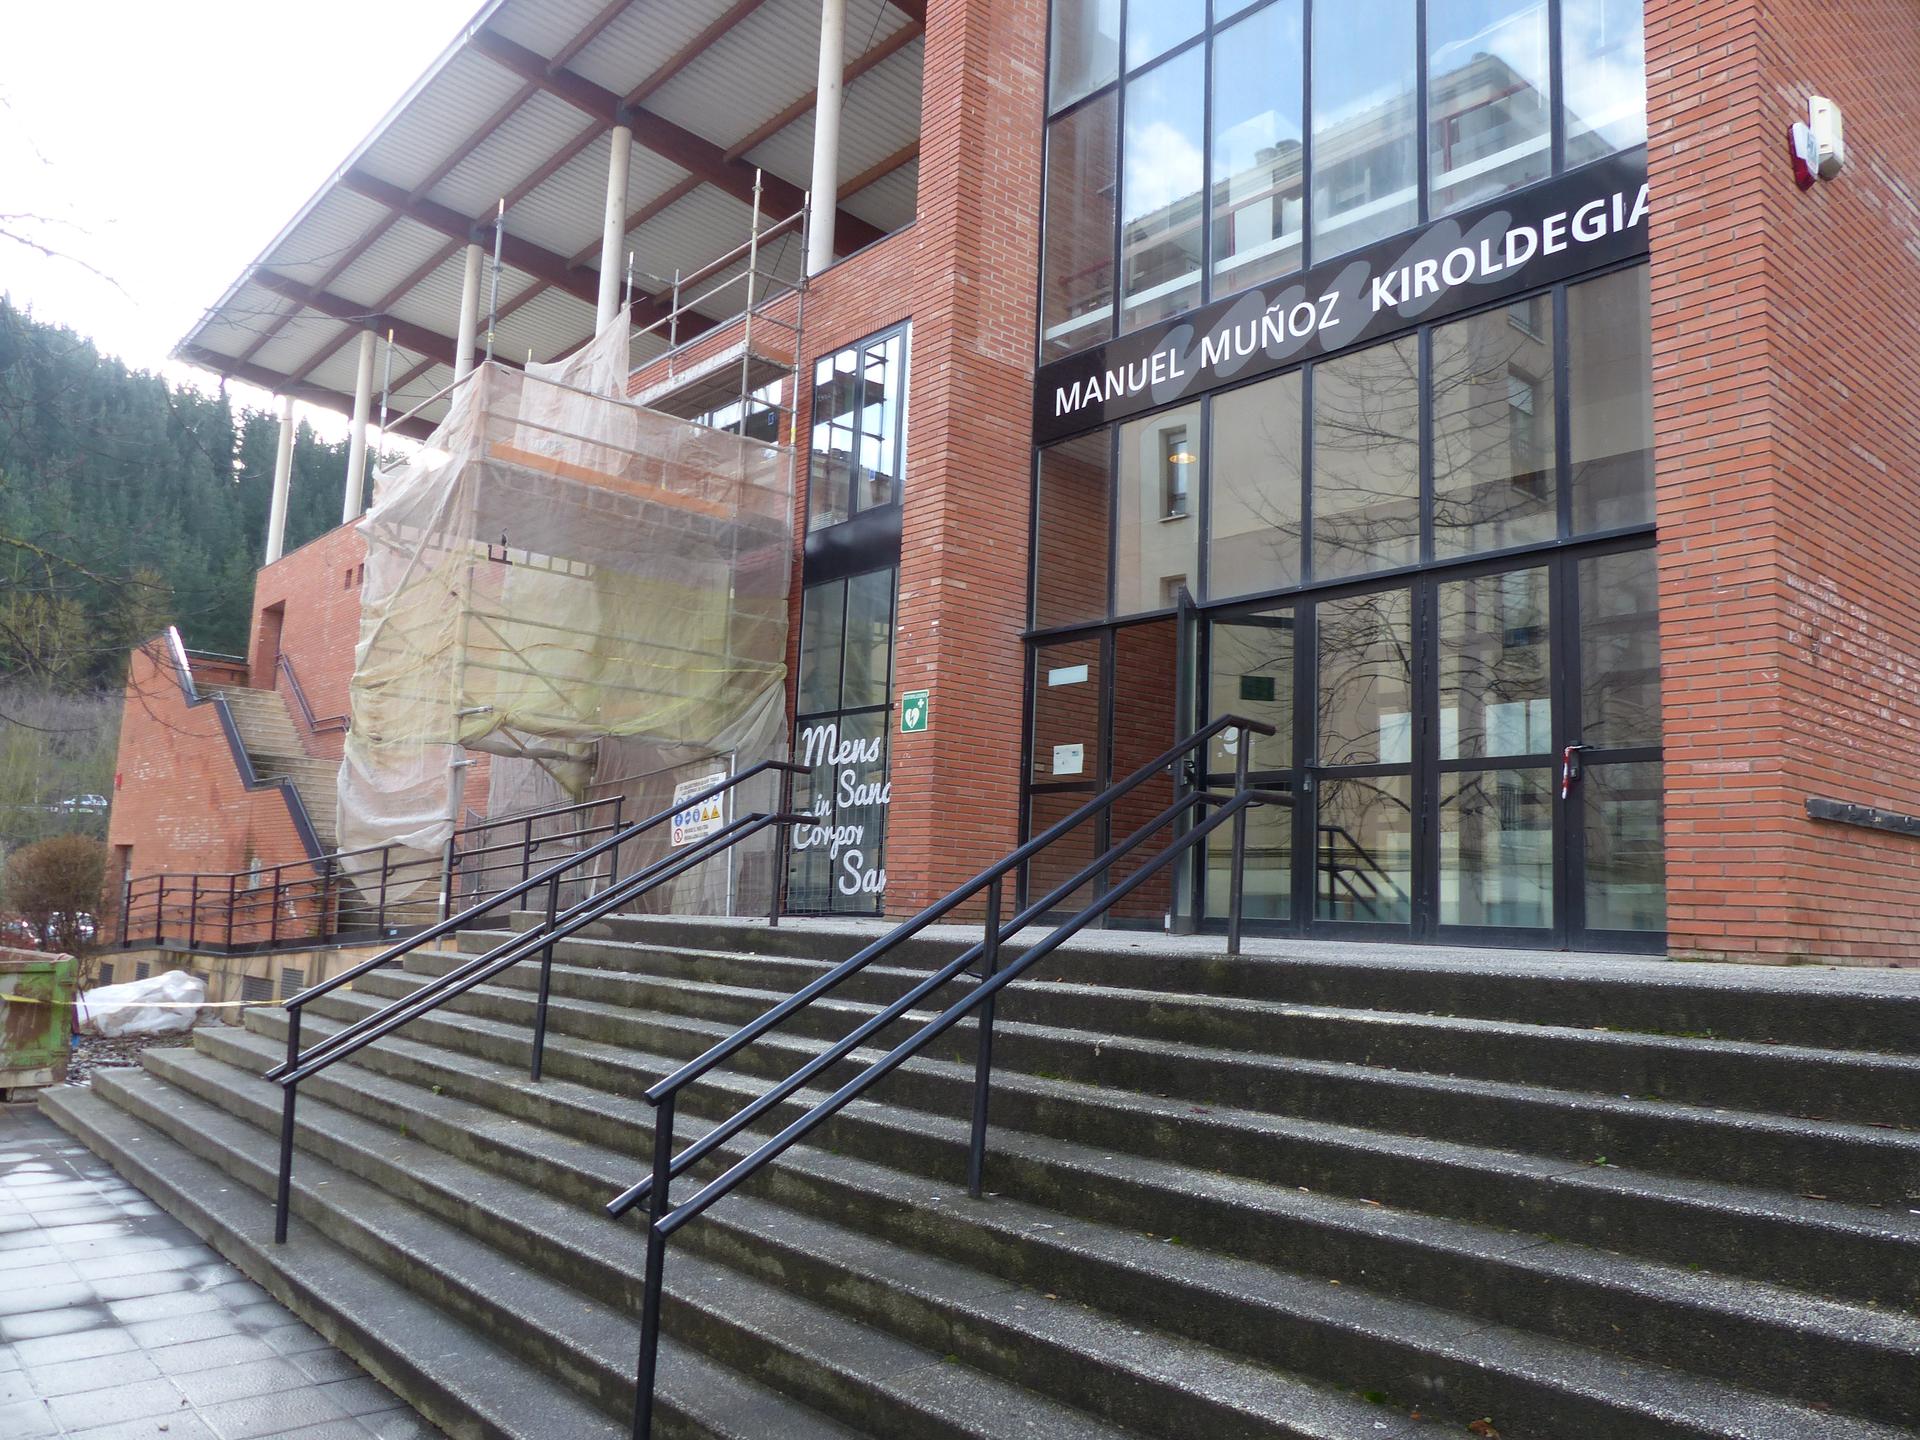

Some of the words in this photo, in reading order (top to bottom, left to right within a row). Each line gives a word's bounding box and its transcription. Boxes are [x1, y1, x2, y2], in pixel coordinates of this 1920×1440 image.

[1055, 347, 1186, 417] MANUEL
[1200, 290, 1341, 369] MUÑOZ
[801, 723, 882, 767] Mens
[814, 792, 833, 817] in
